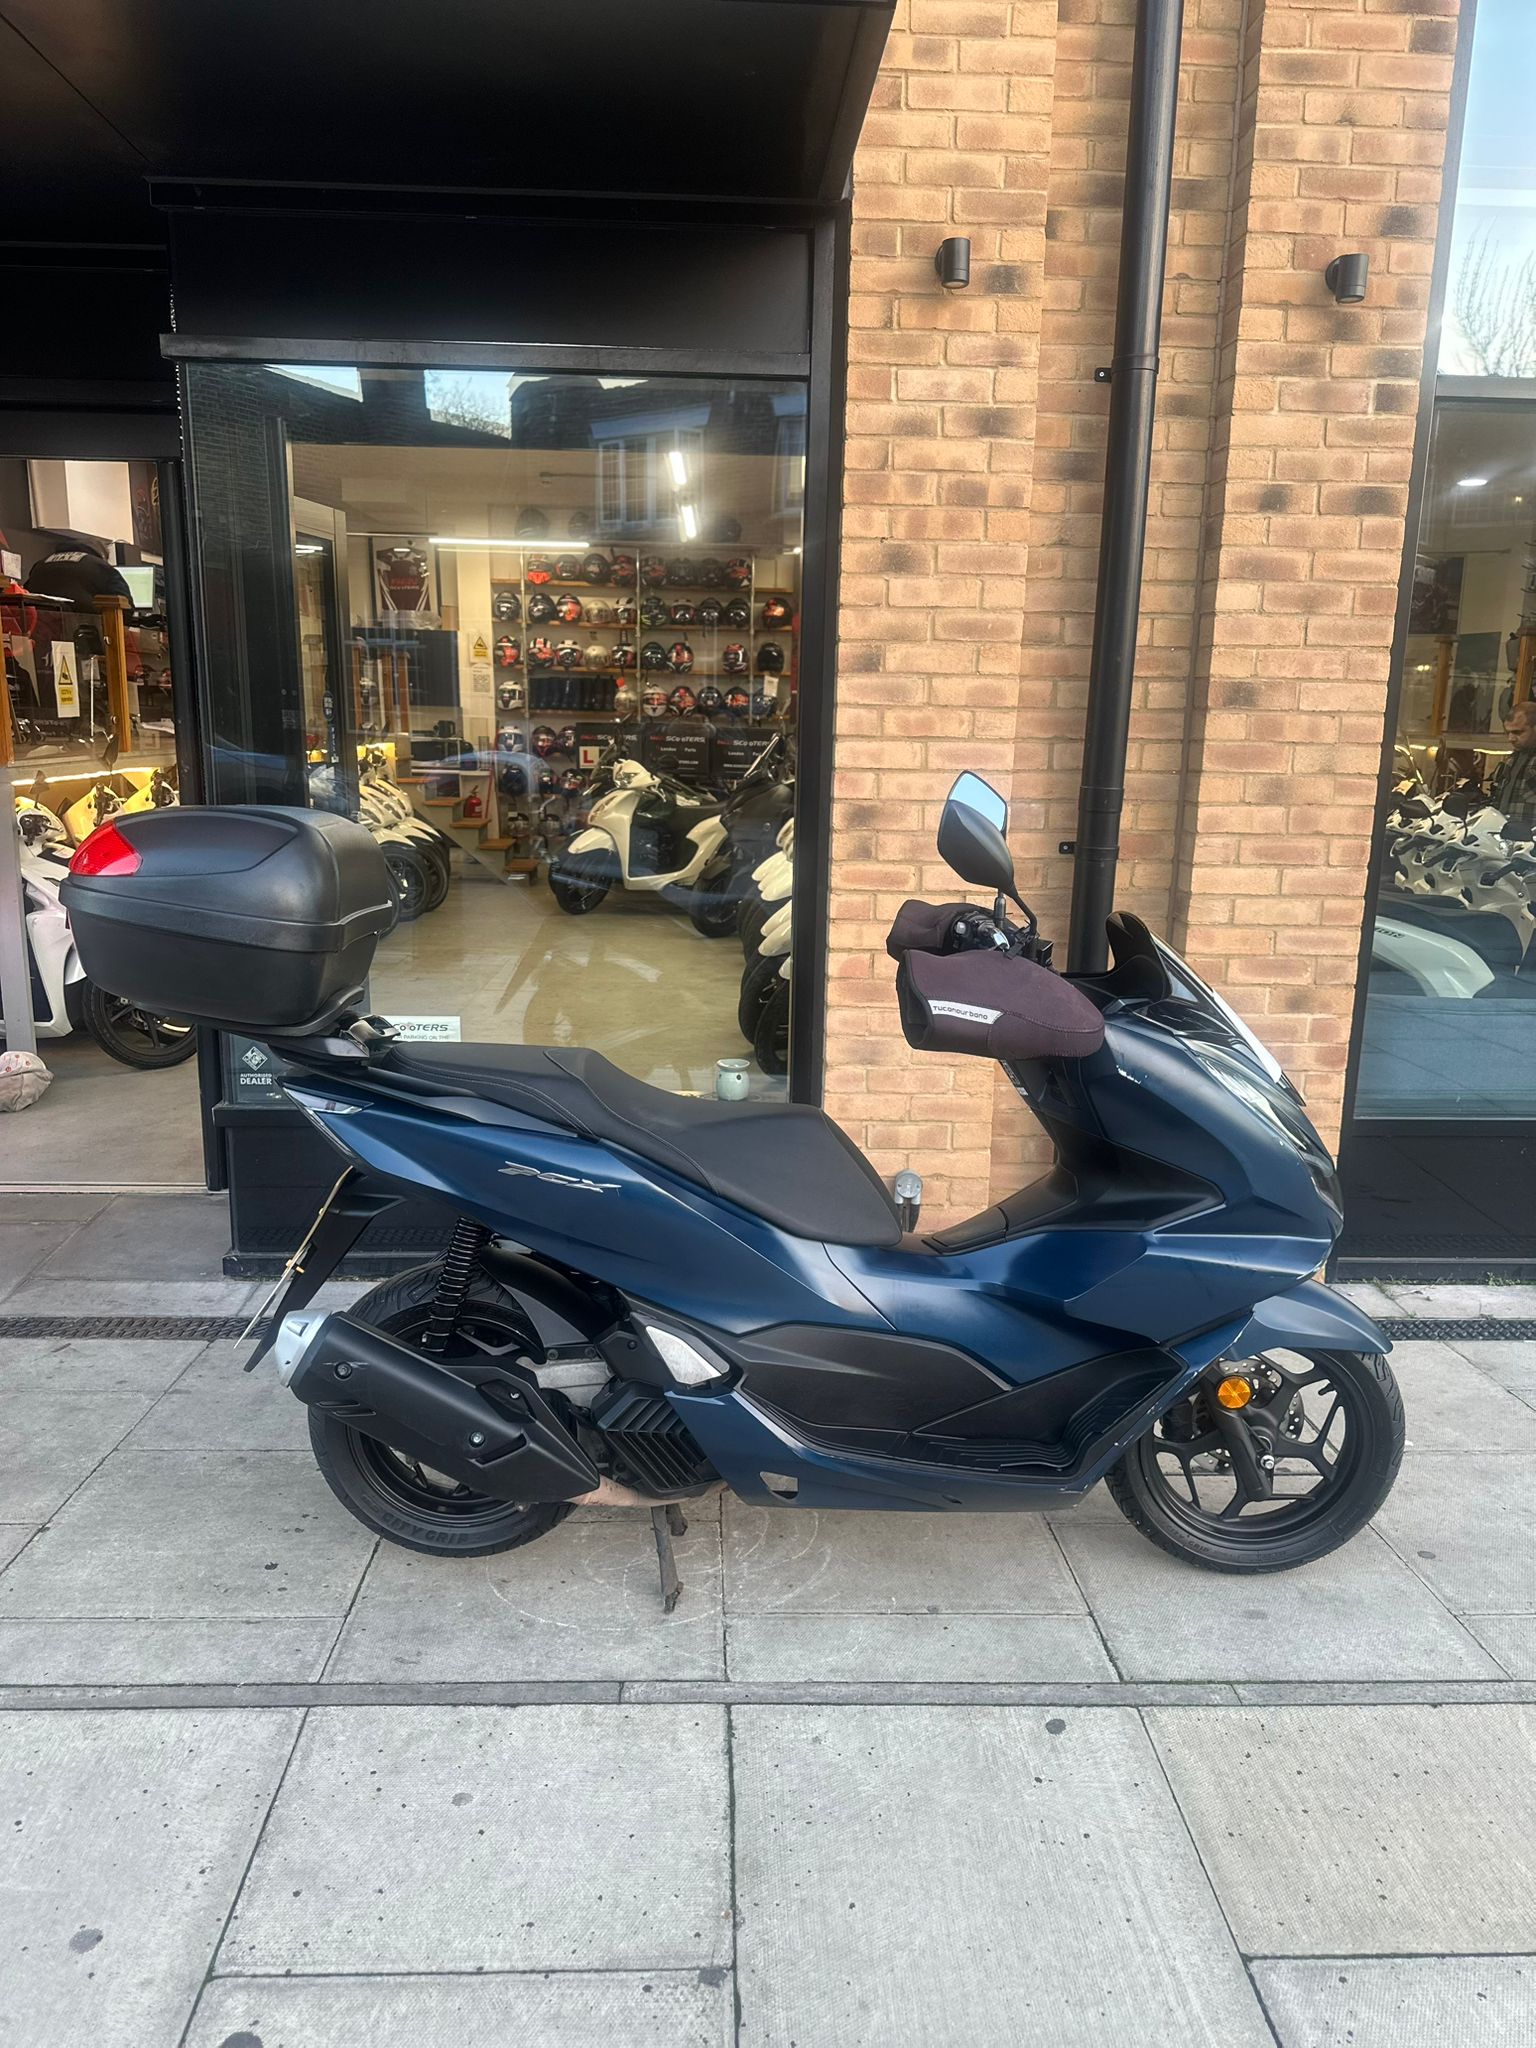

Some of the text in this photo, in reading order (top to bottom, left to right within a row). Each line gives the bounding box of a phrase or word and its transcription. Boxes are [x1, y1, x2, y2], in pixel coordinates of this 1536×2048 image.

[583, 750, 594, 764] L
[497, 1160, 622, 1193] PCX
[382, 1512, 469, 1544] CITY GRIP
